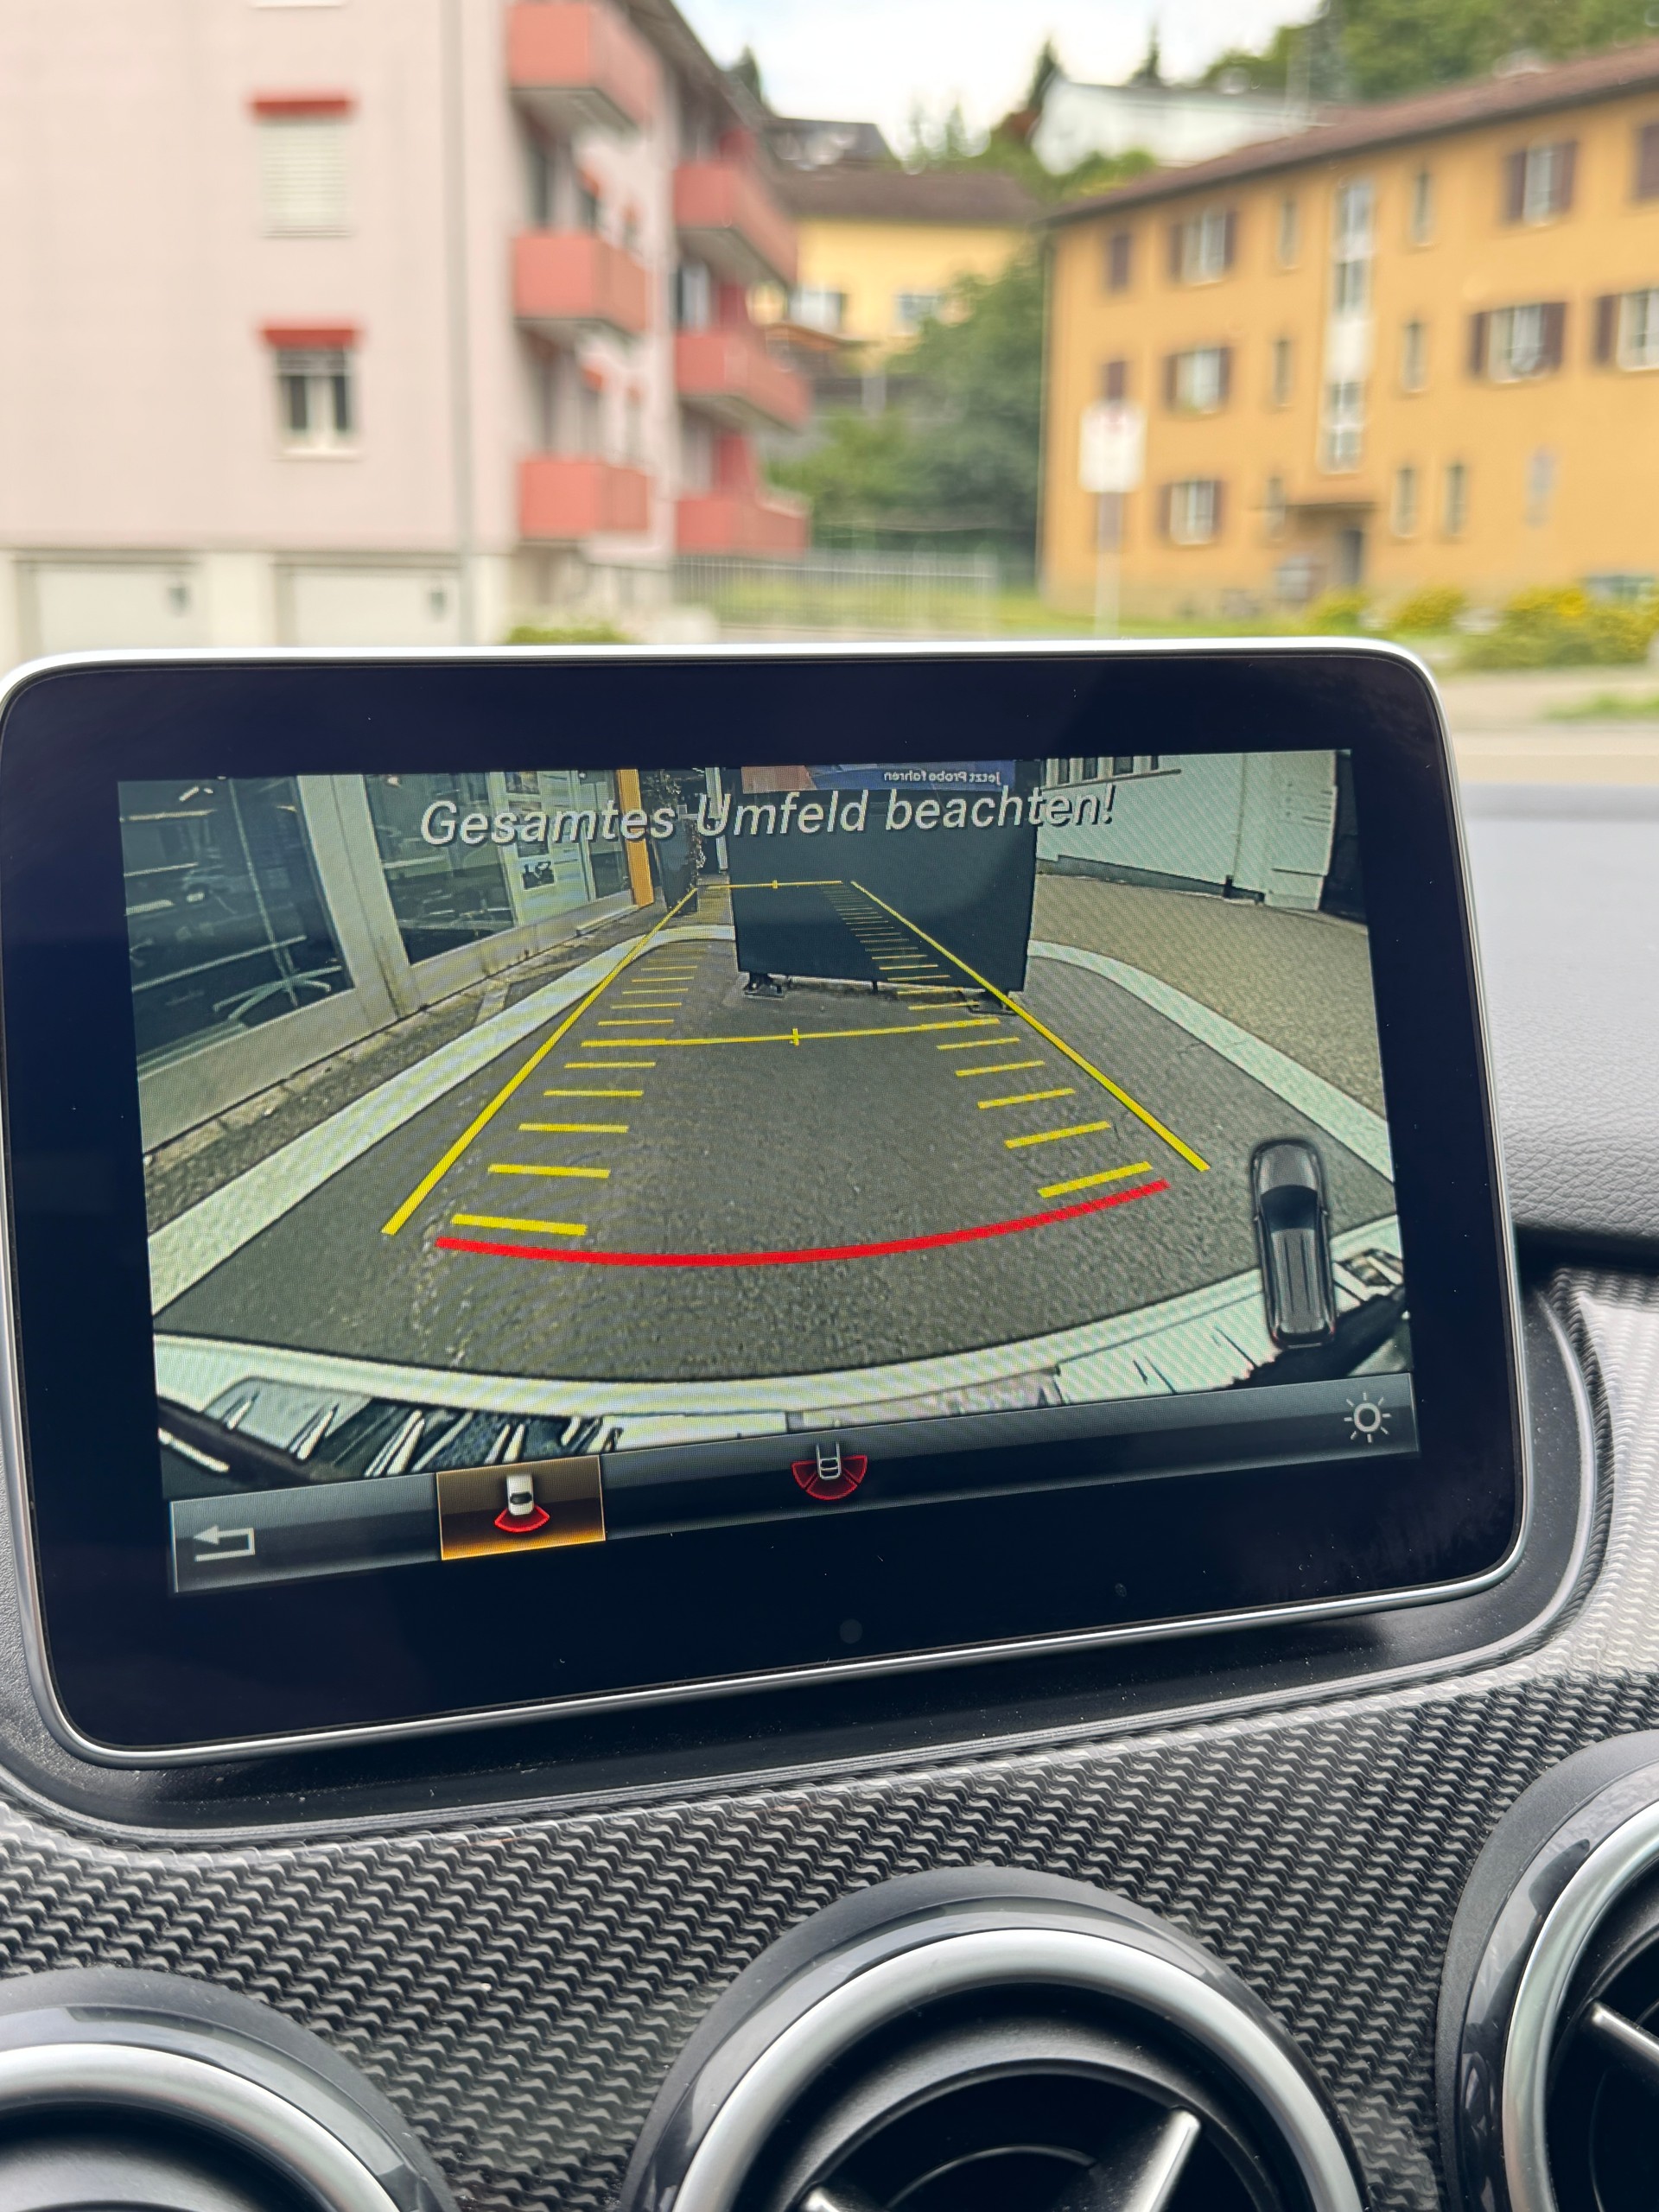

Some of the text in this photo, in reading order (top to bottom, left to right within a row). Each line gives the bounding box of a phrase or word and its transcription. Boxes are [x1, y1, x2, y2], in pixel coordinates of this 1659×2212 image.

[421, 783, 1114, 845] Gesamtes Umfeld beachten!
